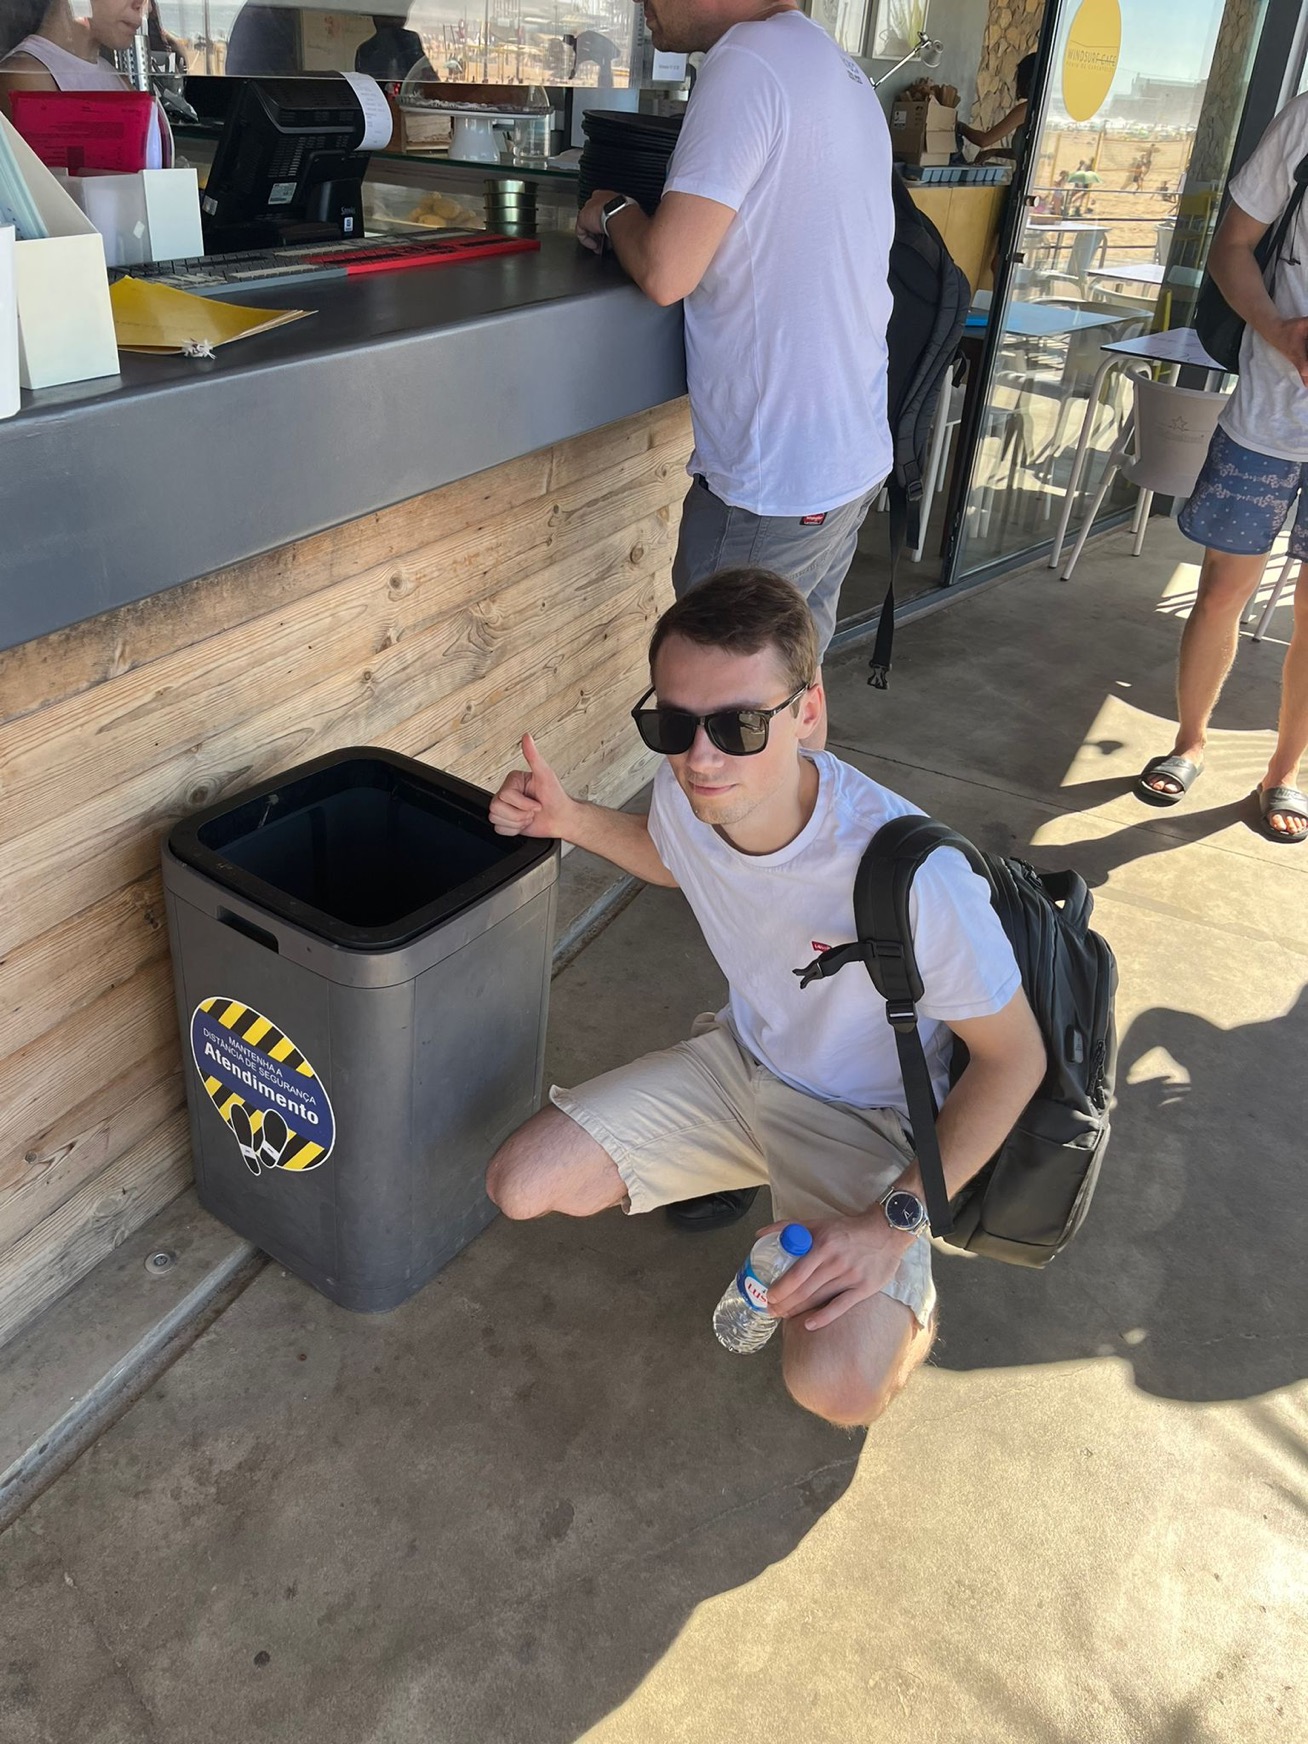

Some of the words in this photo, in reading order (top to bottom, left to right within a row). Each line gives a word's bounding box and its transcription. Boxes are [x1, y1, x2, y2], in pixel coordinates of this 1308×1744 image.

[203, 1027, 245, 1064] DISTÂNCIA
[245, 1057, 257, 1072] DE
[258, 1066, 317, 1106] SEGURANÇA
[204, 1041, 319, 1125] Atendimento
[228, 1036, 276, 1073] MANTENHA
[275, 1068, 283, 1078] A
